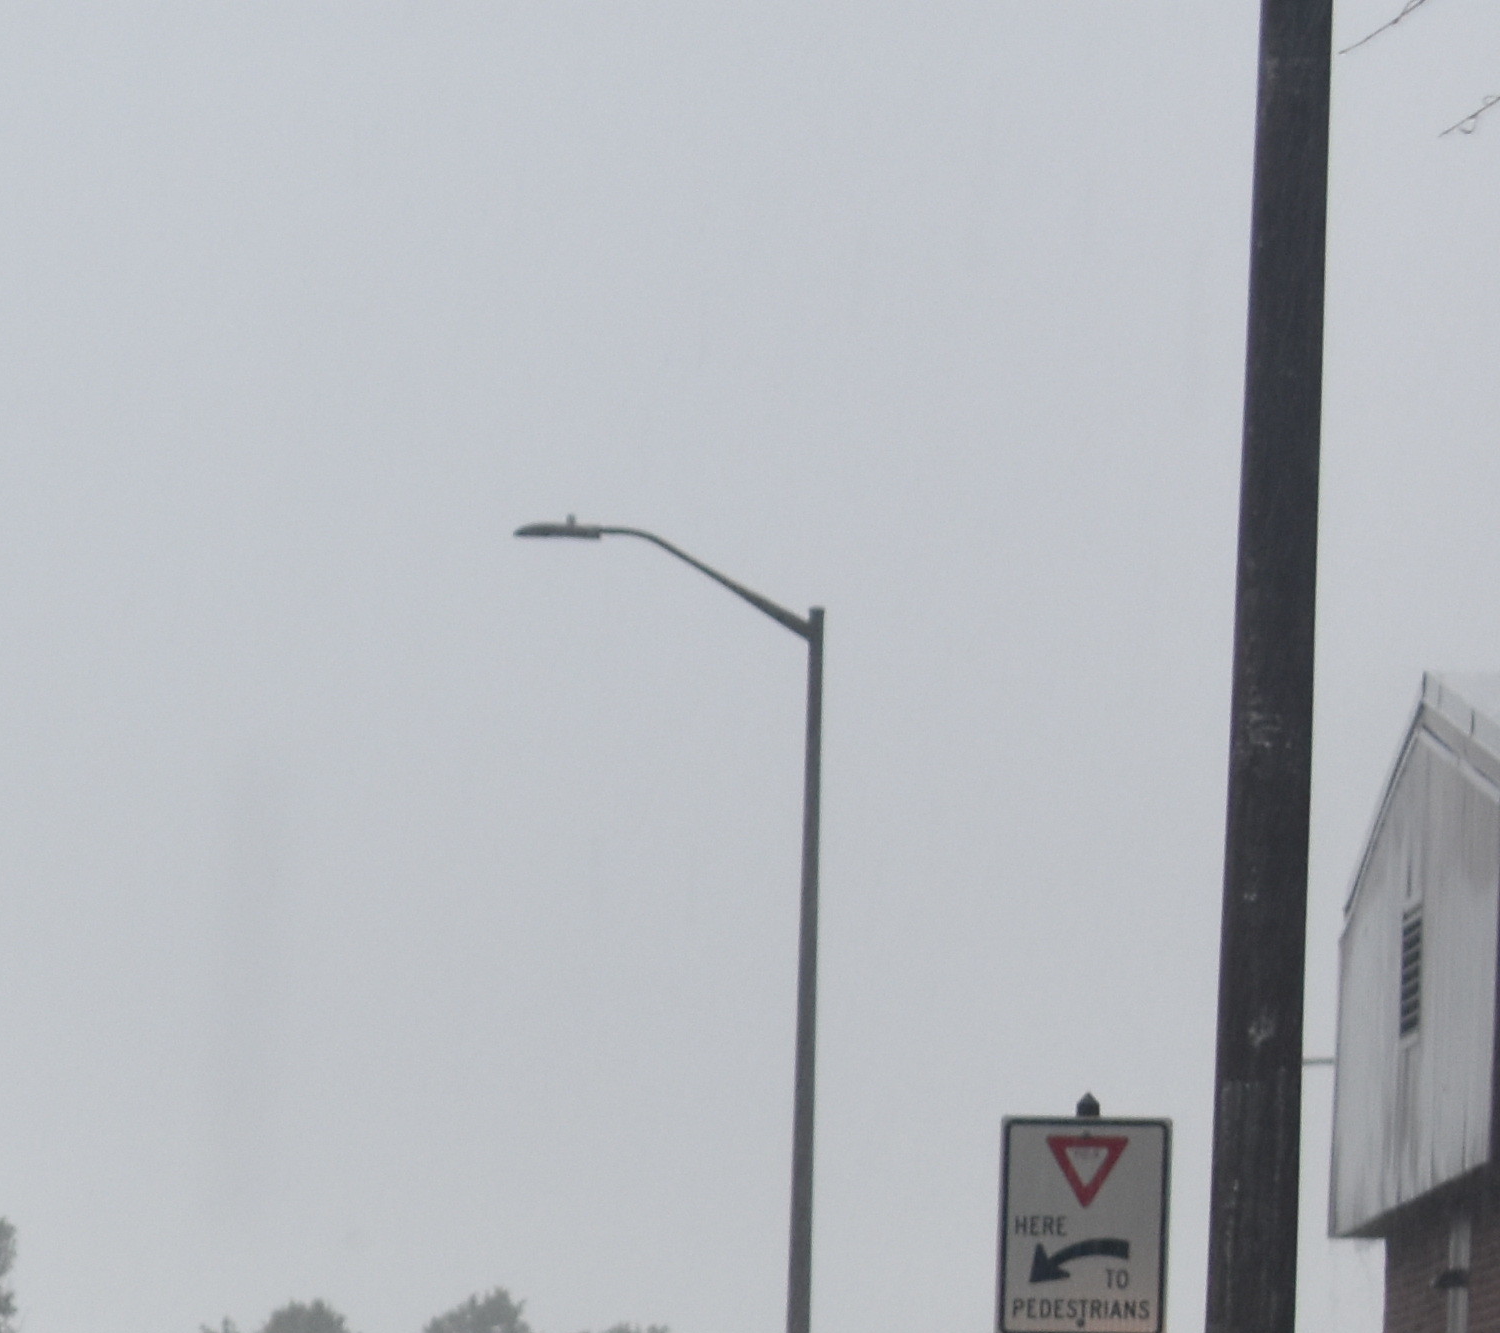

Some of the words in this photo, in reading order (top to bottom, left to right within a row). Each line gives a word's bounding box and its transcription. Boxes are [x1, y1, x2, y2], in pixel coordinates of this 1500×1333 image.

[1015, 1215, 1068, 1237] HERE
[1105, 1268, 1129, 1289] TO
[1012, 1298, 1150, 1319] PEDESTRIANS
